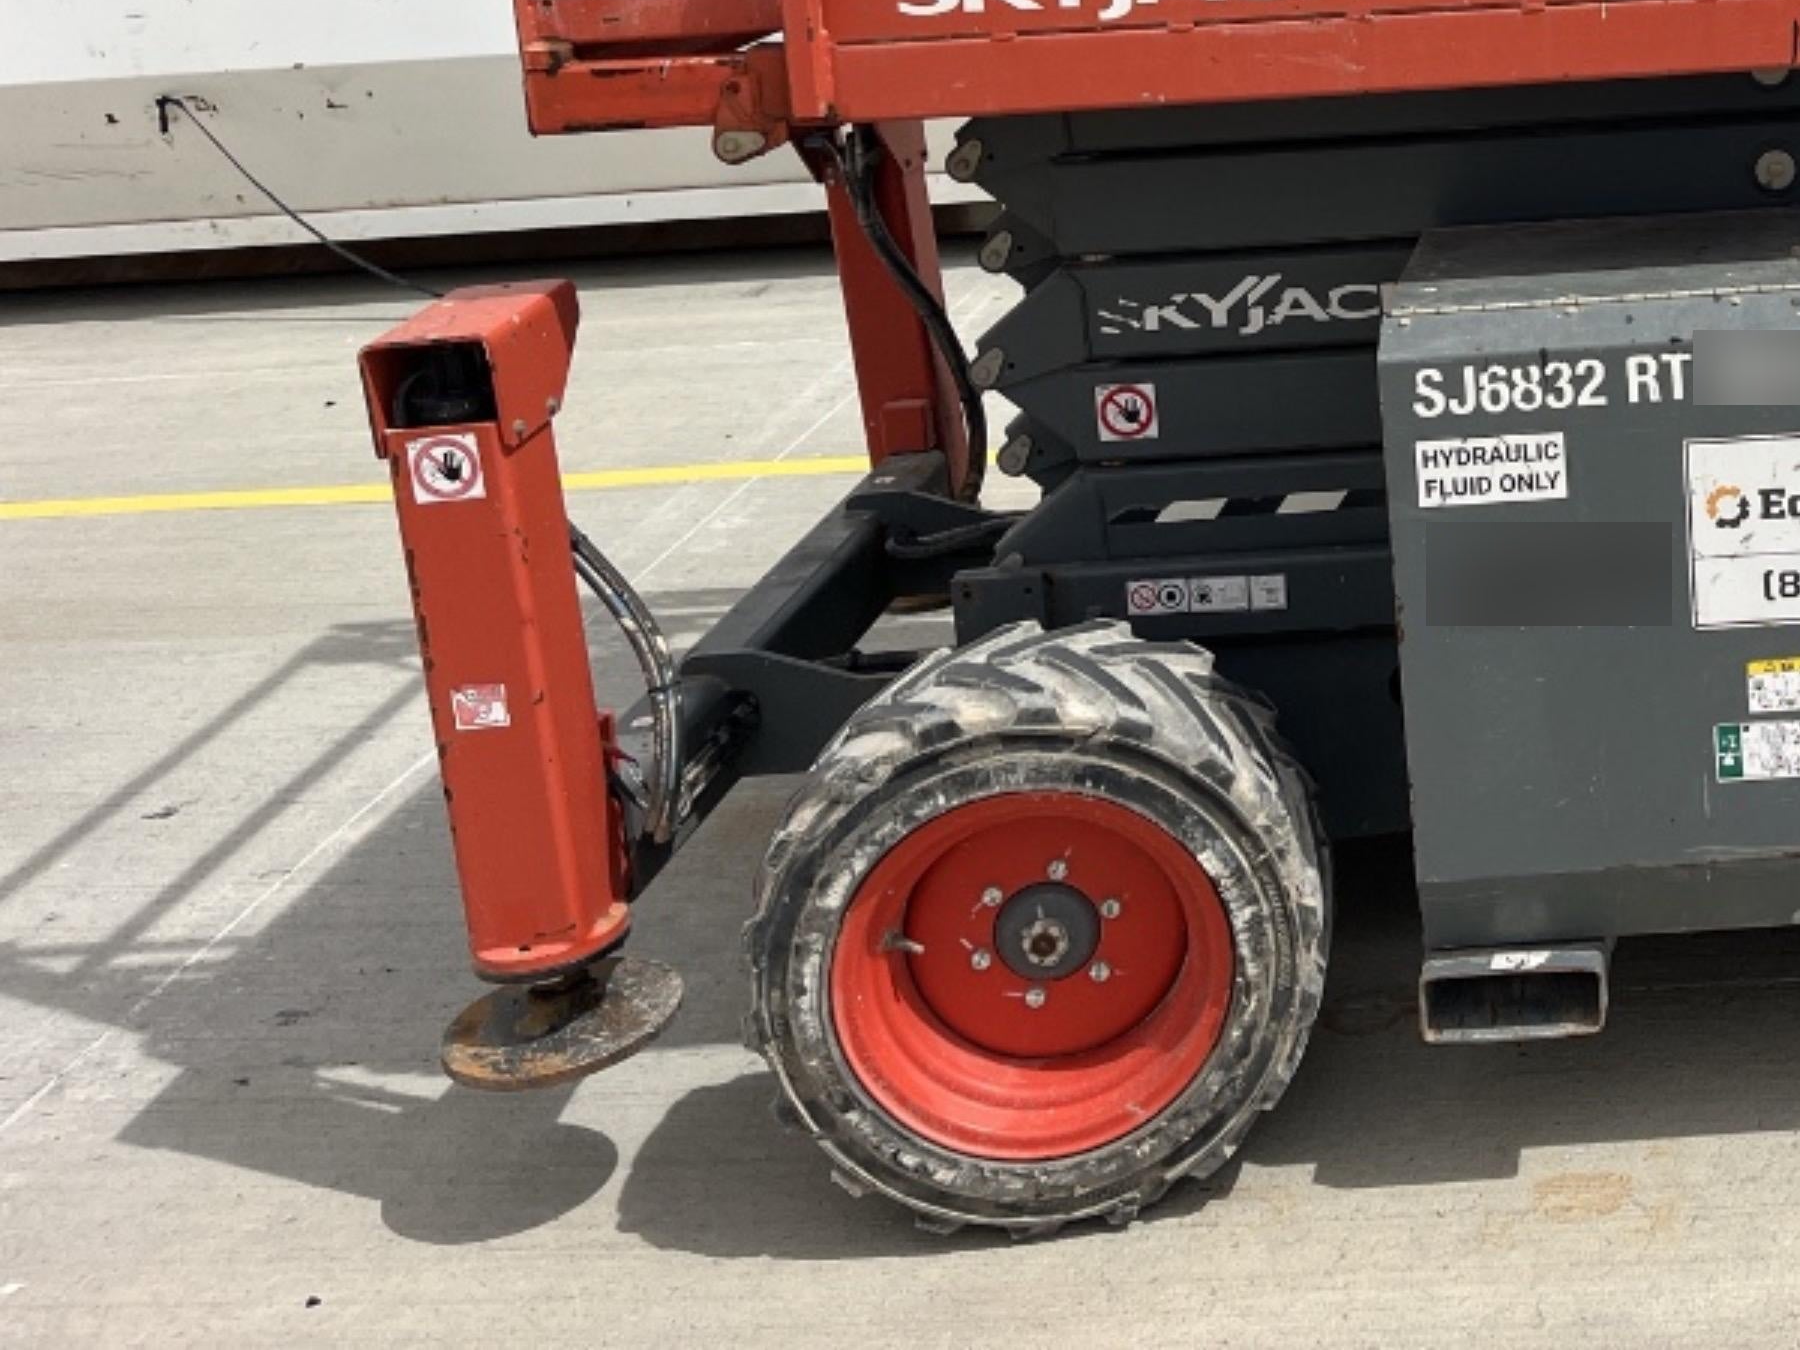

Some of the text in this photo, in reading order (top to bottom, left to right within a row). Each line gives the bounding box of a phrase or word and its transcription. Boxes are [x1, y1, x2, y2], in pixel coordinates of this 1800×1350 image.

[1098, 272, 1381, 336] SKYJAC
[1412, 353, 1693, 419] SJ6832 RT
[1421, 441, 1561, 470] HYDRAULIC
[1424, 471, 1561, 499] FLUID ONLY
